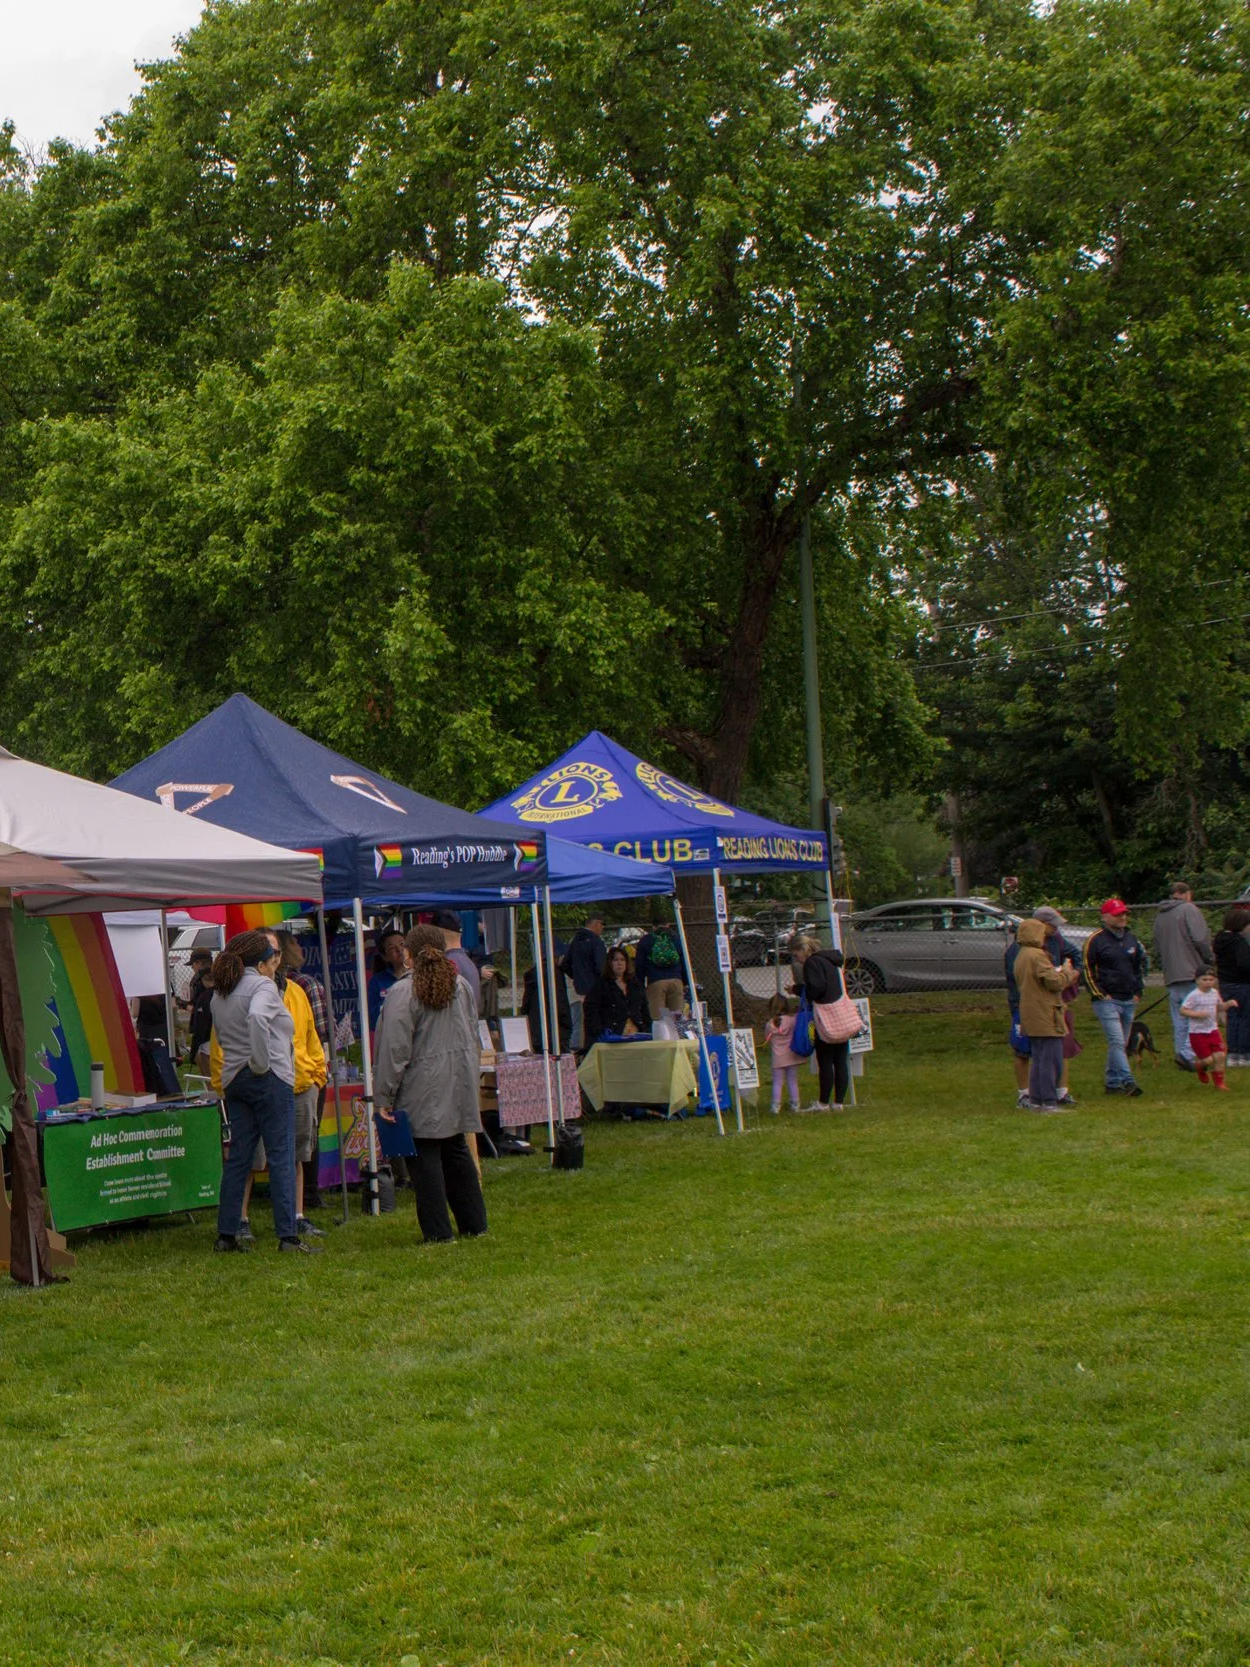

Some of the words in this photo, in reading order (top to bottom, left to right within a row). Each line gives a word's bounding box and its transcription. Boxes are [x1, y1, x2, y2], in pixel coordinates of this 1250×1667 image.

[546, 763, 608, 783] LIONS
[550, 780, 580, 803] L
[411, 846, 455, 869] Reading's
[456, 845, 477, 863] POP
[477, 845, 508, 862] Huddle
[614, 838, 693, 863] CLUB
[723, 837, 769, 860] READING
[769, 837, 798, 861] LIONS
[799, 839, 823, 862] CLUB
[90, 1133, 102, 1148] Ad
[103, 1132, 118, 1146] Hoc
[86, 1149, 144, 1171] Establishment
